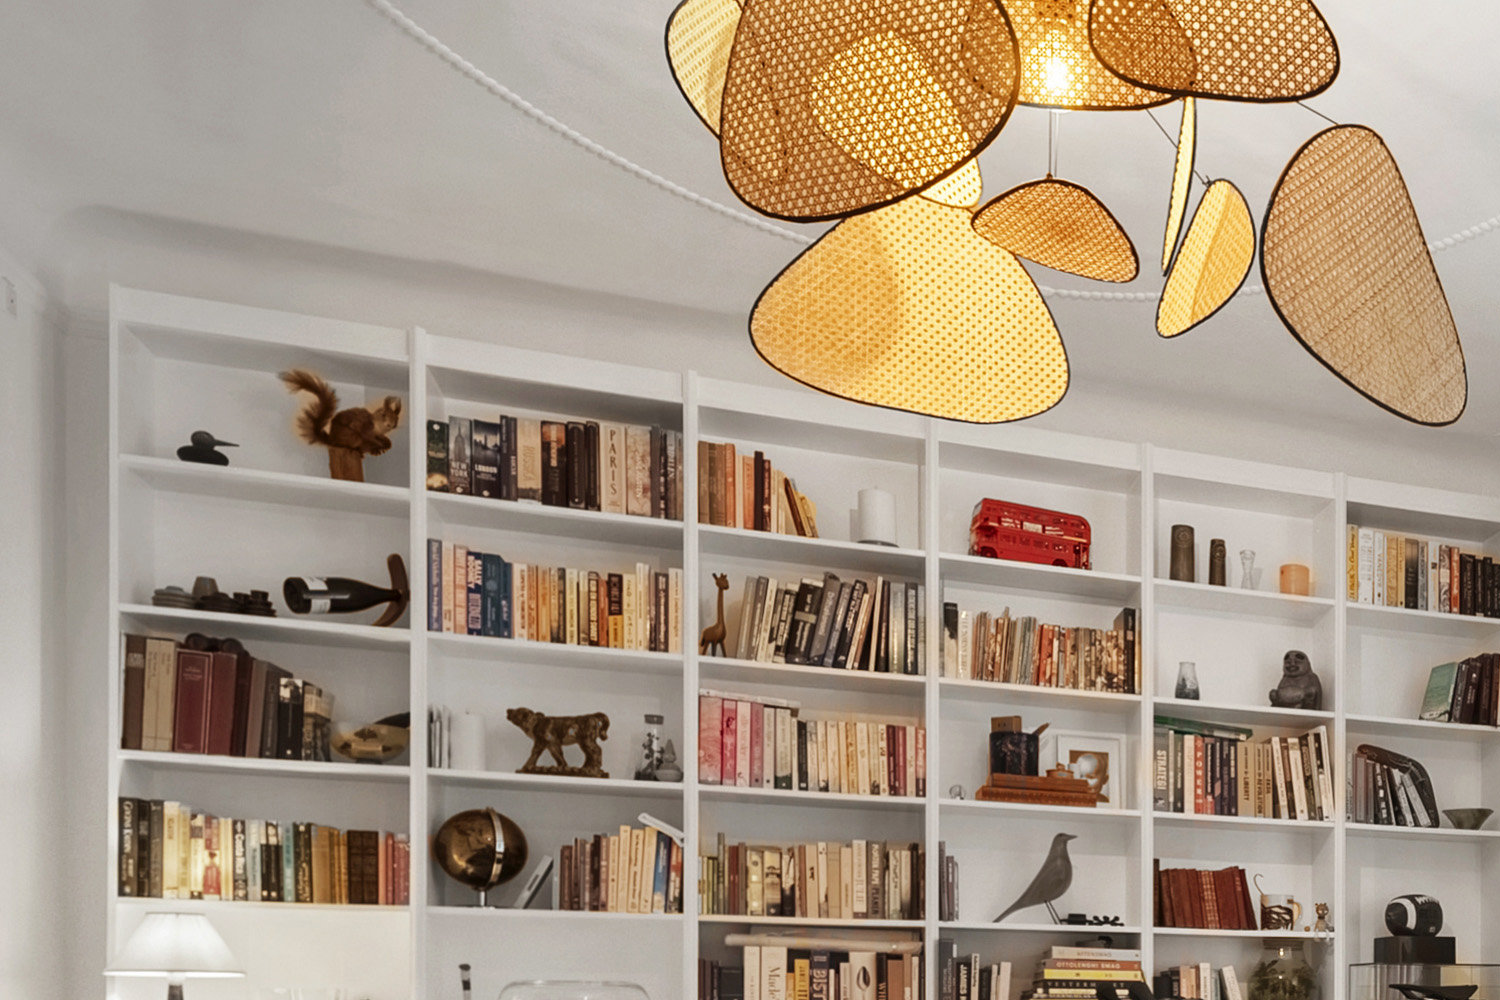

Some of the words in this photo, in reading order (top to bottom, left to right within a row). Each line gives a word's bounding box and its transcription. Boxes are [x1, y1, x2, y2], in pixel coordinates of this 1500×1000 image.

[609, 429, 617, 495] PARIS
[1157, 750, 1167, 790] STRATEGI
[235, 834, 244, 857] Costa
[236, 857, 244, 874] Rica
[768, 967, 781, 999] Made
